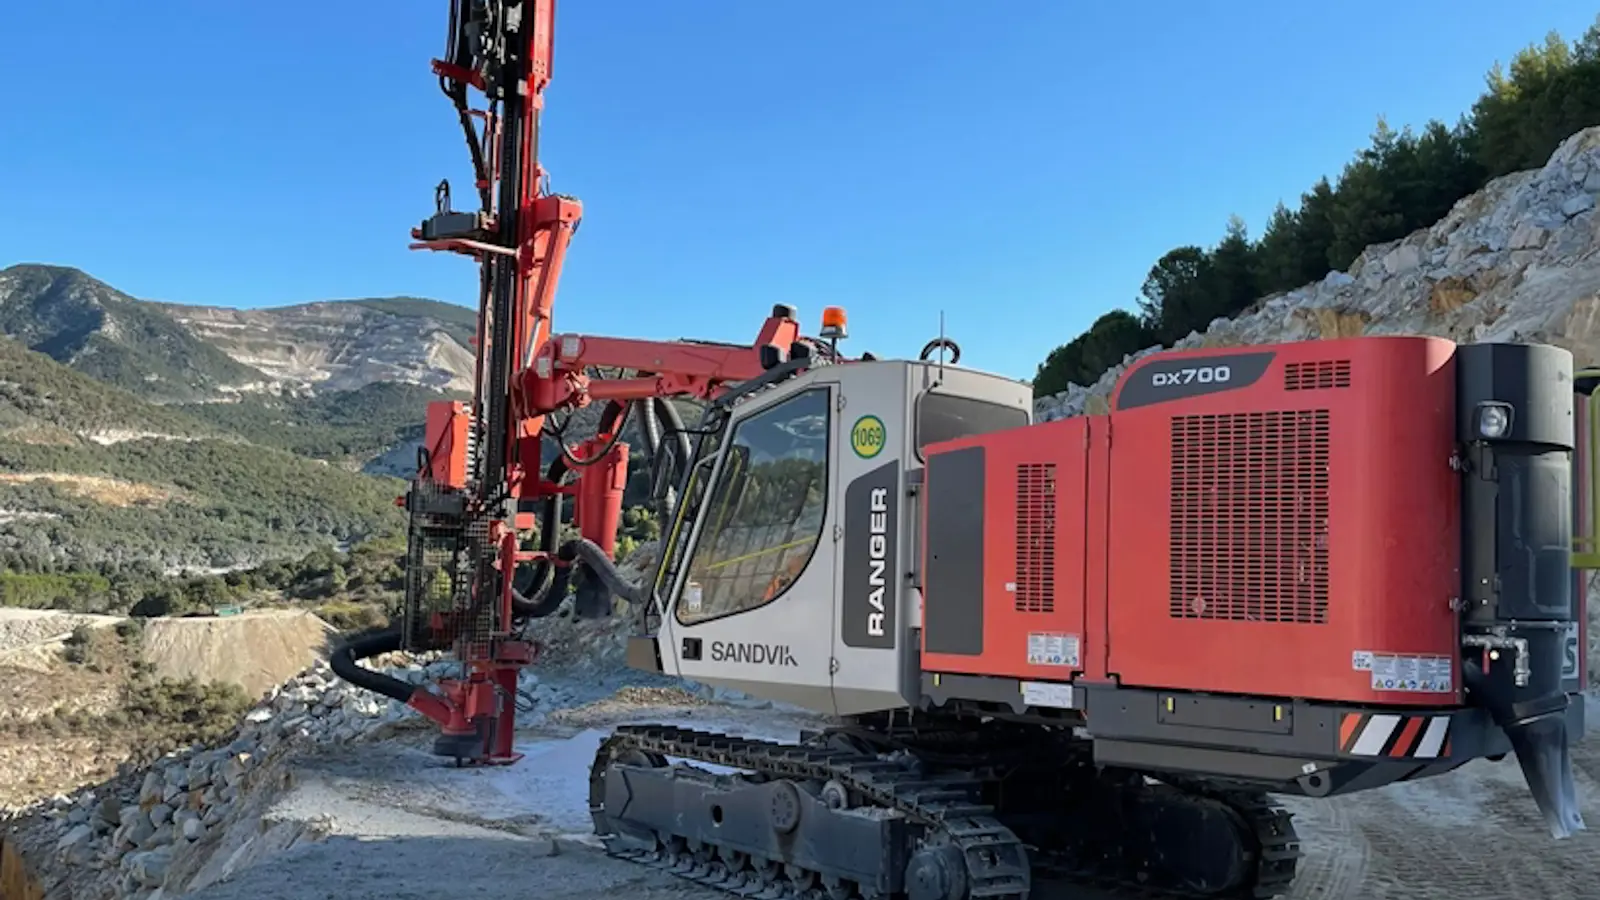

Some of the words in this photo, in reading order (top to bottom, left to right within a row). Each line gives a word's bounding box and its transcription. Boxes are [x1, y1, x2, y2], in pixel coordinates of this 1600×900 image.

[1152, 366, 1230, 386] DX700
[854, 427, 881, 446] 1069
[868, 488, 887, 636] RANGER
[711, 641, 798, 666] SANDVIK
